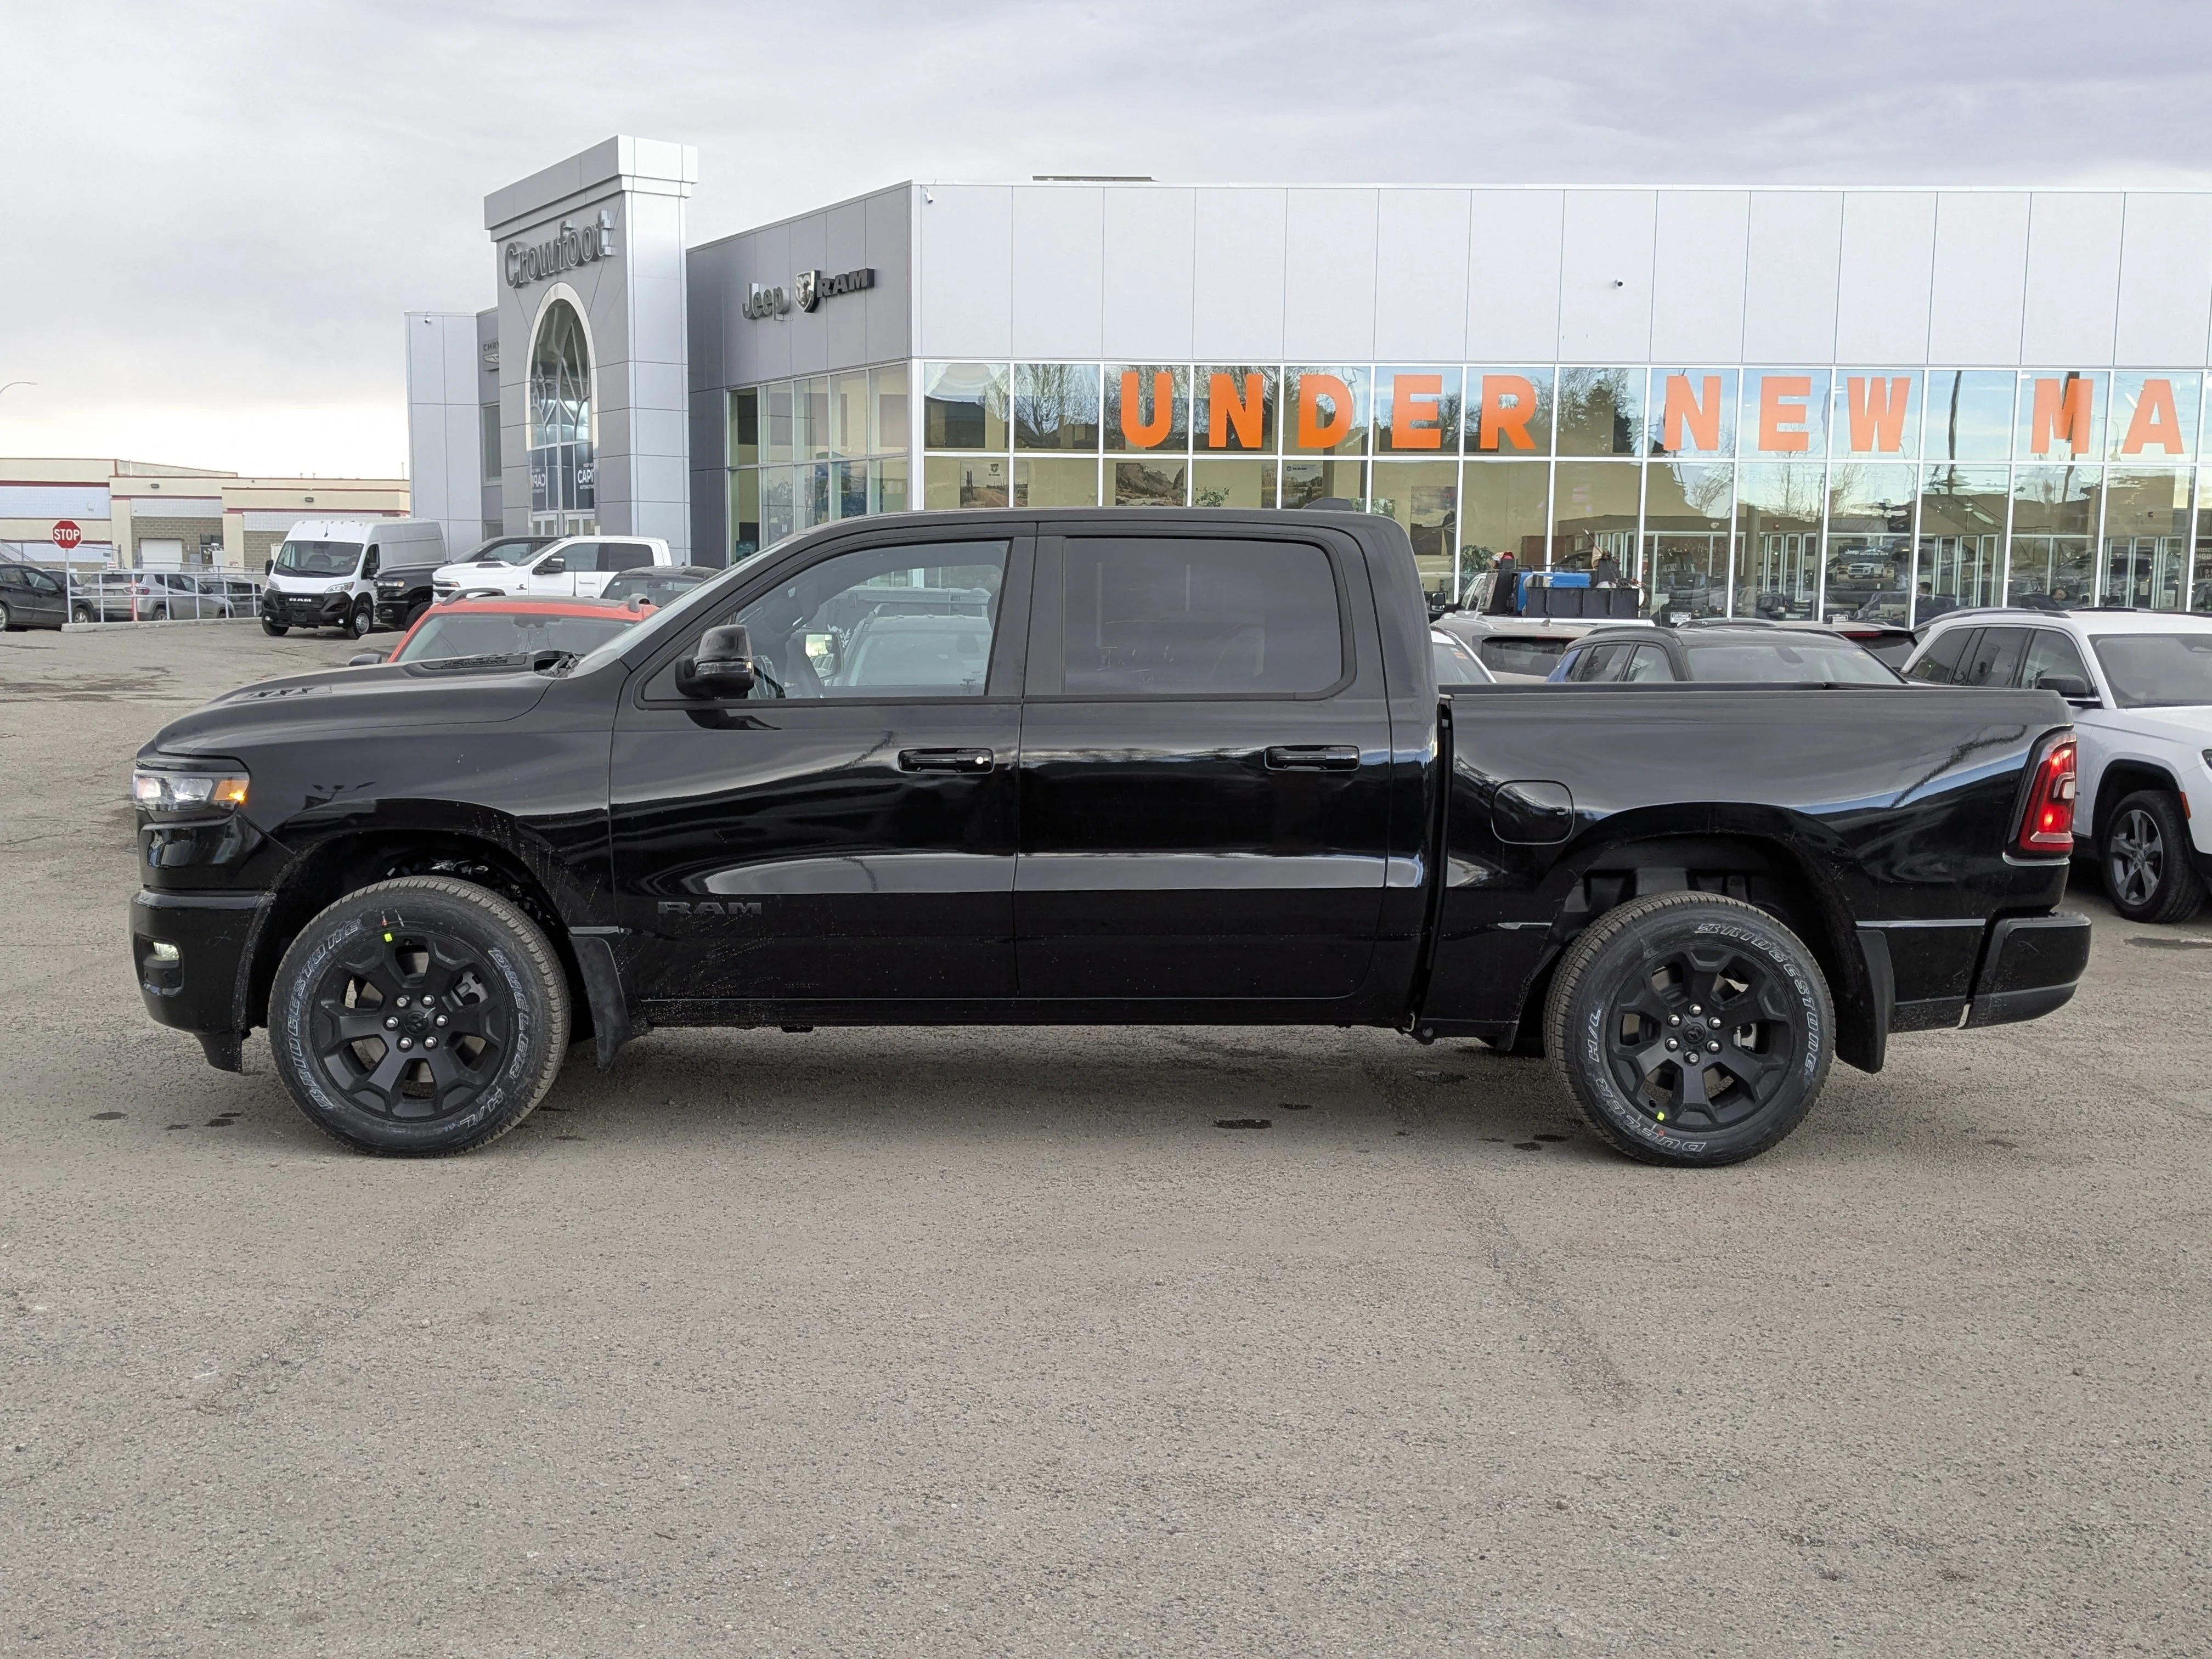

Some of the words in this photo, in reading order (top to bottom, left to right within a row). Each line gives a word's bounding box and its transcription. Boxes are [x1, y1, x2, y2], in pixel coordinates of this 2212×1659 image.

[505, 210, 612, 288] Crowfoot
[742, 283, 790, 321] Jeep
[816, 268, 874, 298] RAM
[1121, 372, 1536, 449] UNDER
[1663, 375, 1911, 453] NEW
[2031, 379, 2184, 455] MA
[54, 528, 80, 541] STOP
[657, 901, 762, 915] RAM
[287, 918, 362, 1109] BRIDGESTONE
[488, 946, 530, 1080] DUELER
[1695, 923, 1819, 1072] BRIDGESTONE
[1588, 1009, 1601, 1063] H/L
[460, 1088, 504, 1128] H/L
[1595, 1078, 1707, 1152] DUELER
